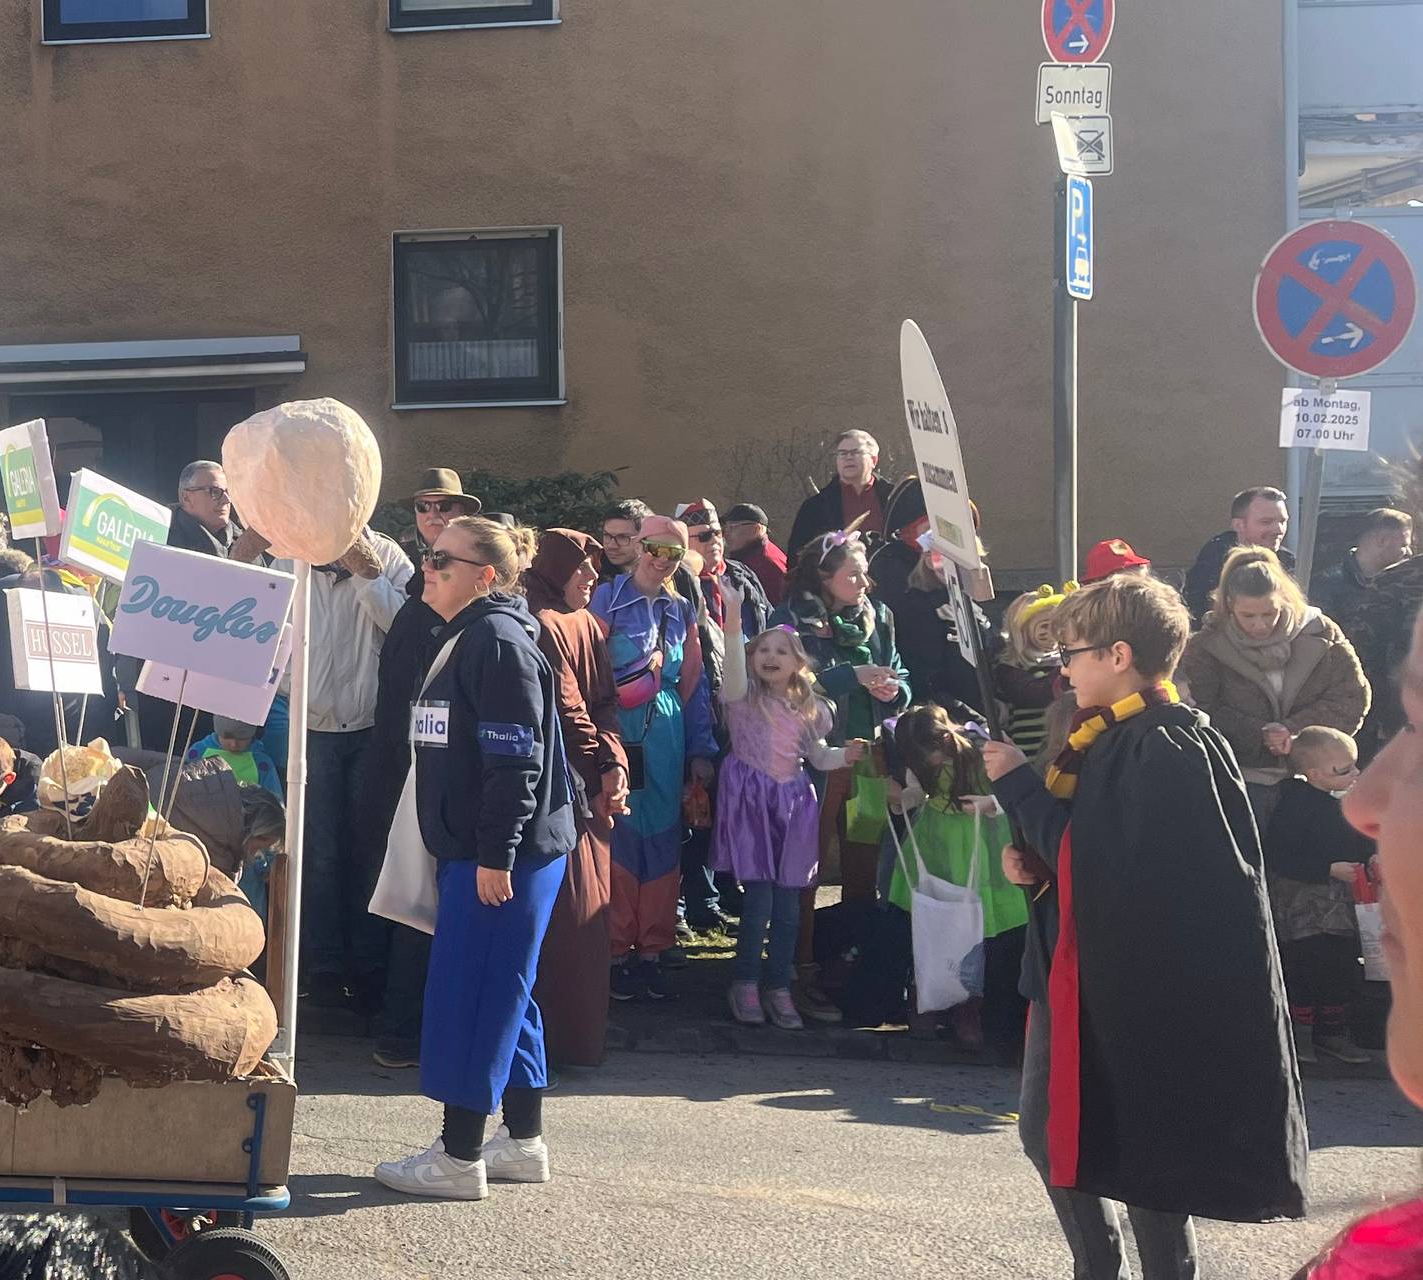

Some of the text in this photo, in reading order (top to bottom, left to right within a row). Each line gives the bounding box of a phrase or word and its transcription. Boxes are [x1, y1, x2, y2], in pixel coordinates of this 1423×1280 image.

[1045, 85, 1103, 108] Sonntag
[1293, 398, 1361, 411] ab Montag,
[1295, 413, 1359, 426] 10.02.2025
[1296, 428, 1355, 441] 07.00 Uhr
[120, 575, 280, 644] Douglas
[30, 626, 92, 658] HUSSEL
[415, 714, 446, 735] alia
[487, 730, 519, 742] Thalia
